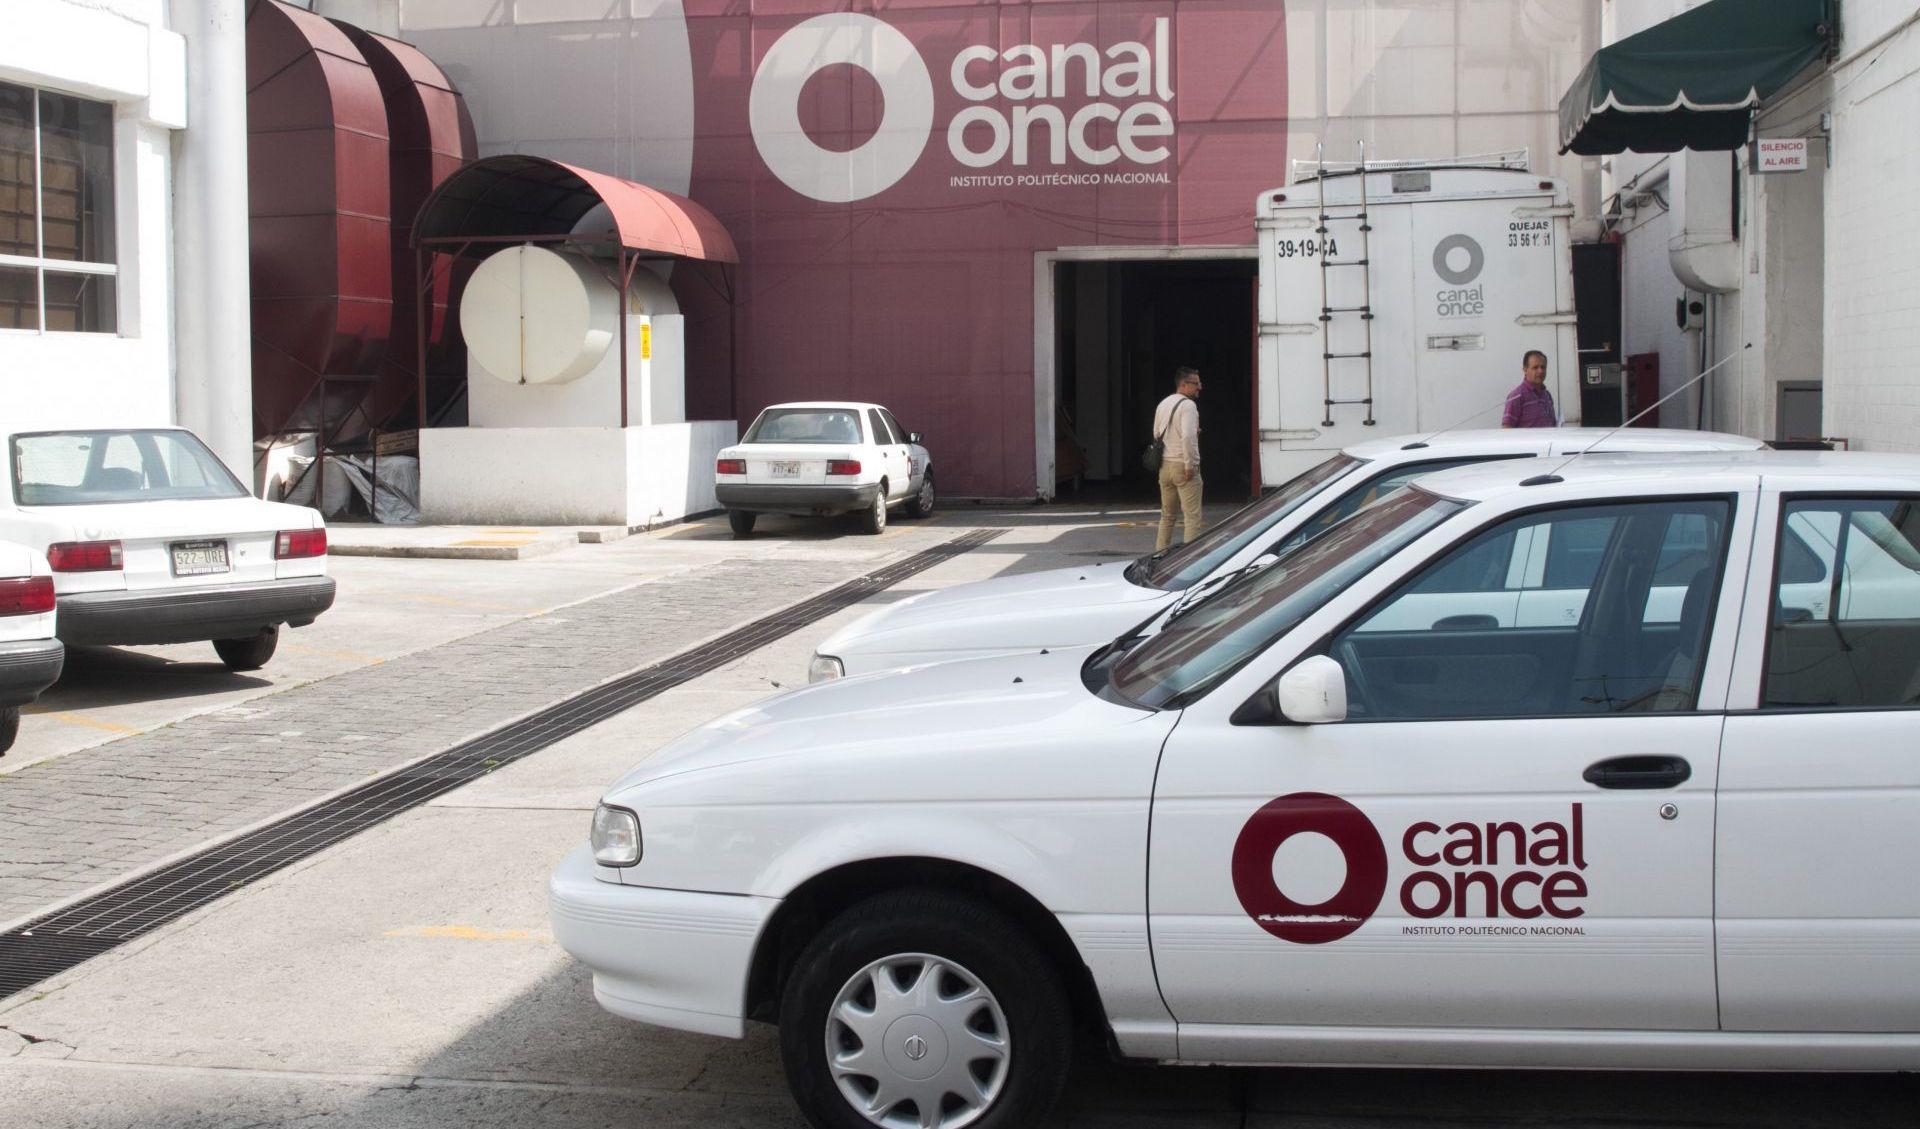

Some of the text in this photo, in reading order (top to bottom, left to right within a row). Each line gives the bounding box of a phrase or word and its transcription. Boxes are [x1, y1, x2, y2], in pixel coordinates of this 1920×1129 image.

[951, 17, 1175, 102] canal
[947, 102, 1175, 168] once
[1761, 143, 1804, 152] SILENCIO
[1765, 157, 1801, 166] AL AIRE
[950, 172, 1172, 187] INSTITUTO POLITÉCNICO NACIONAL
[1509, 221, 1549, 231] QUEJAS
[1508, 233, 1518, 247] 53
[1521, 233, 1530, 247] 56
[1278, 239, 1338, 258] 39-19-CA
[1436, 284, 1484, 302] canal
[1436, 301, 1484, 316] once
[1402, 803, 1588, 871] canal
[1400, 870, 1588, 919] once
[1402, 925, 1586, 936] INSTITUTO POLITÉCNICO NACIONAL
